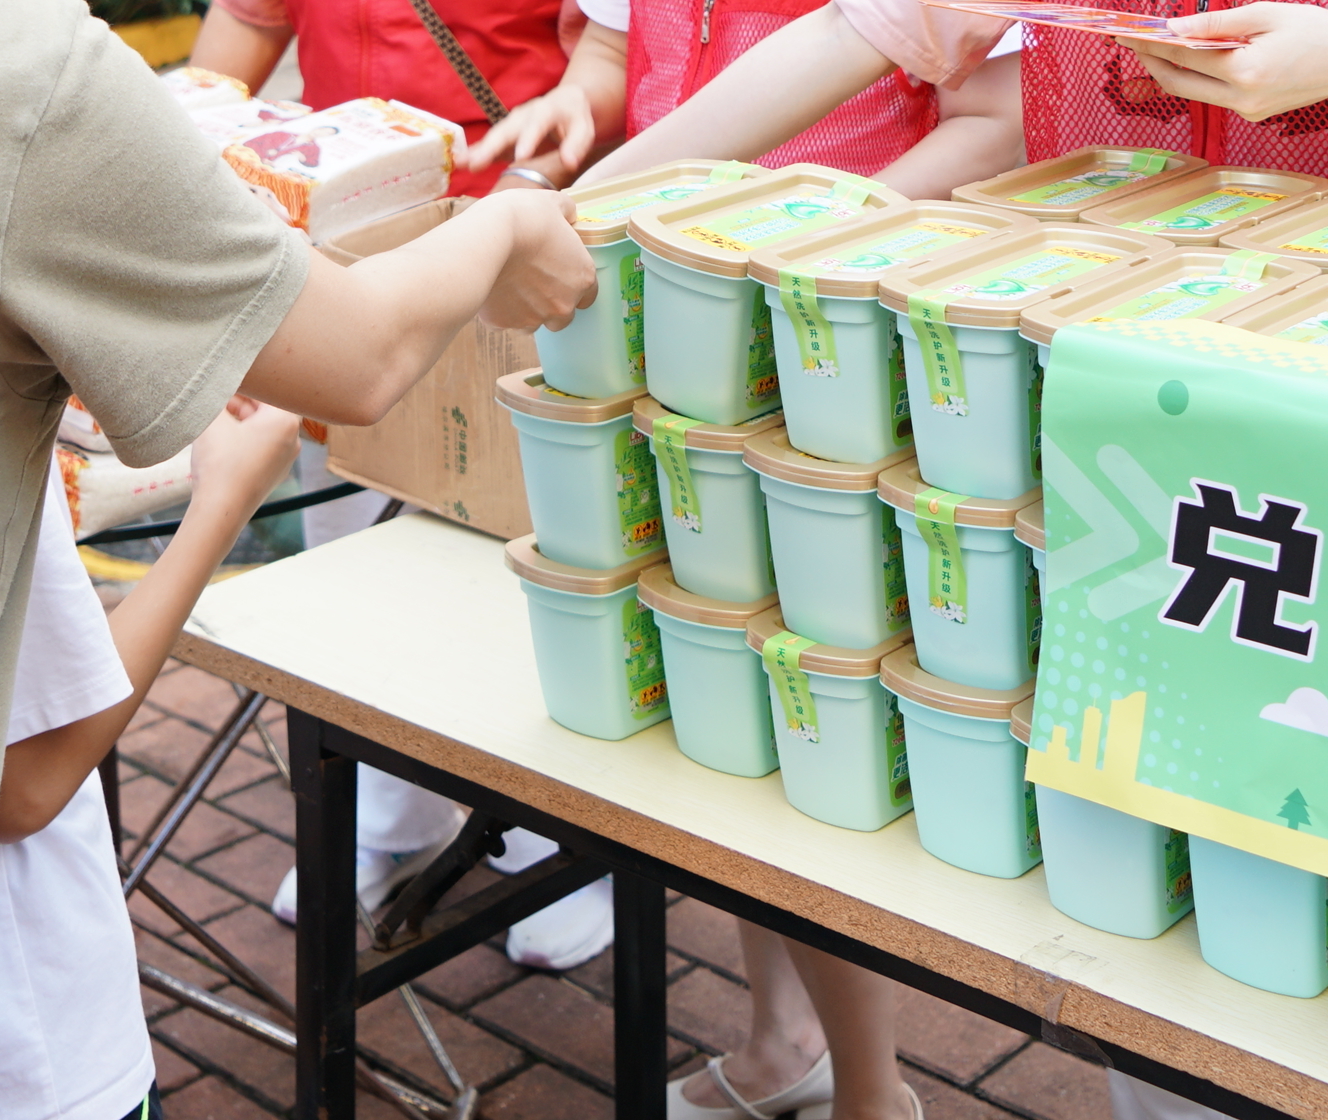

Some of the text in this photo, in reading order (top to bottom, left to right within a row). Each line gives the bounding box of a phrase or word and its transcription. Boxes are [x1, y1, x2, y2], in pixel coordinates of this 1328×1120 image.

[791, 276, 821, 352] 天然洗护新升级
[922, 308, 951, 388] 天然洗护新升级
